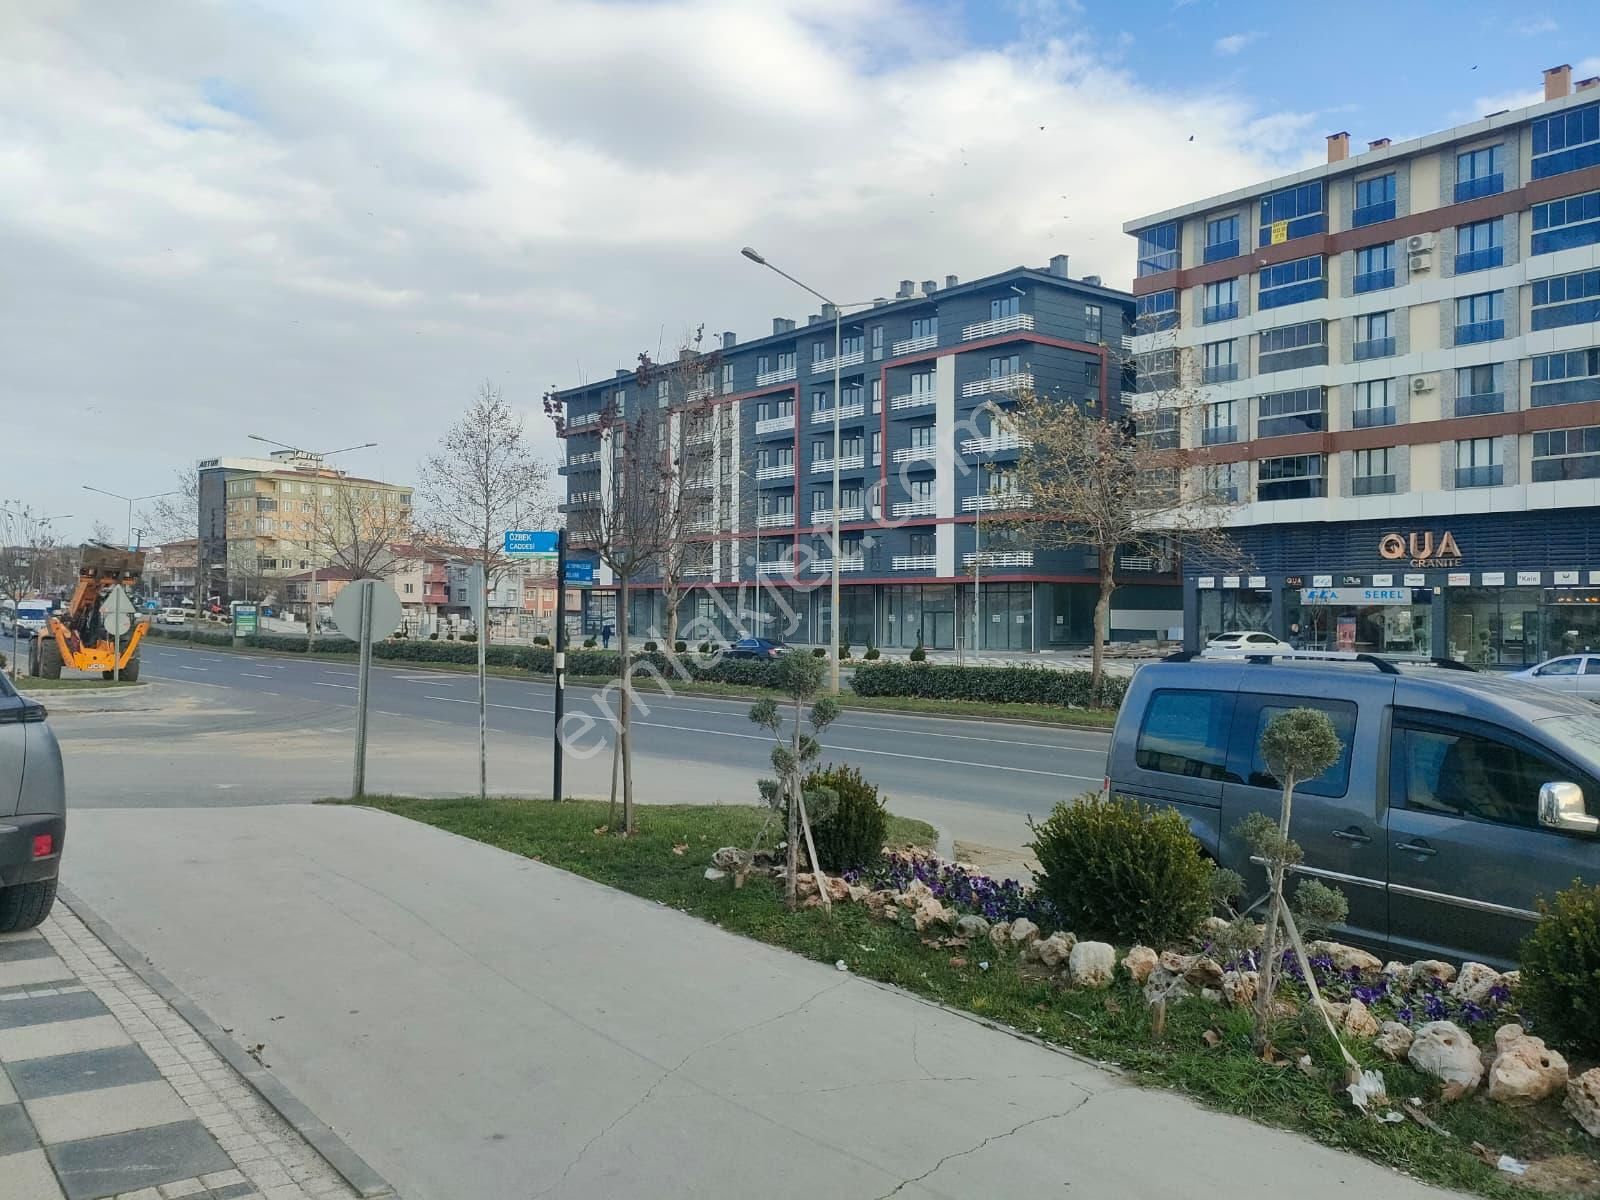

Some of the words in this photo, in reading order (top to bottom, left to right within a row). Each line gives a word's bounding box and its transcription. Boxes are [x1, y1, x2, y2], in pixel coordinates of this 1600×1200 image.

[509, 533, 532, 541] ÖZBEK
[1379, 531, 1462, 559] QUA
[1410, 559, 1463, 568] GRANITE
[1364, 590, 1403, 598] SEREL
